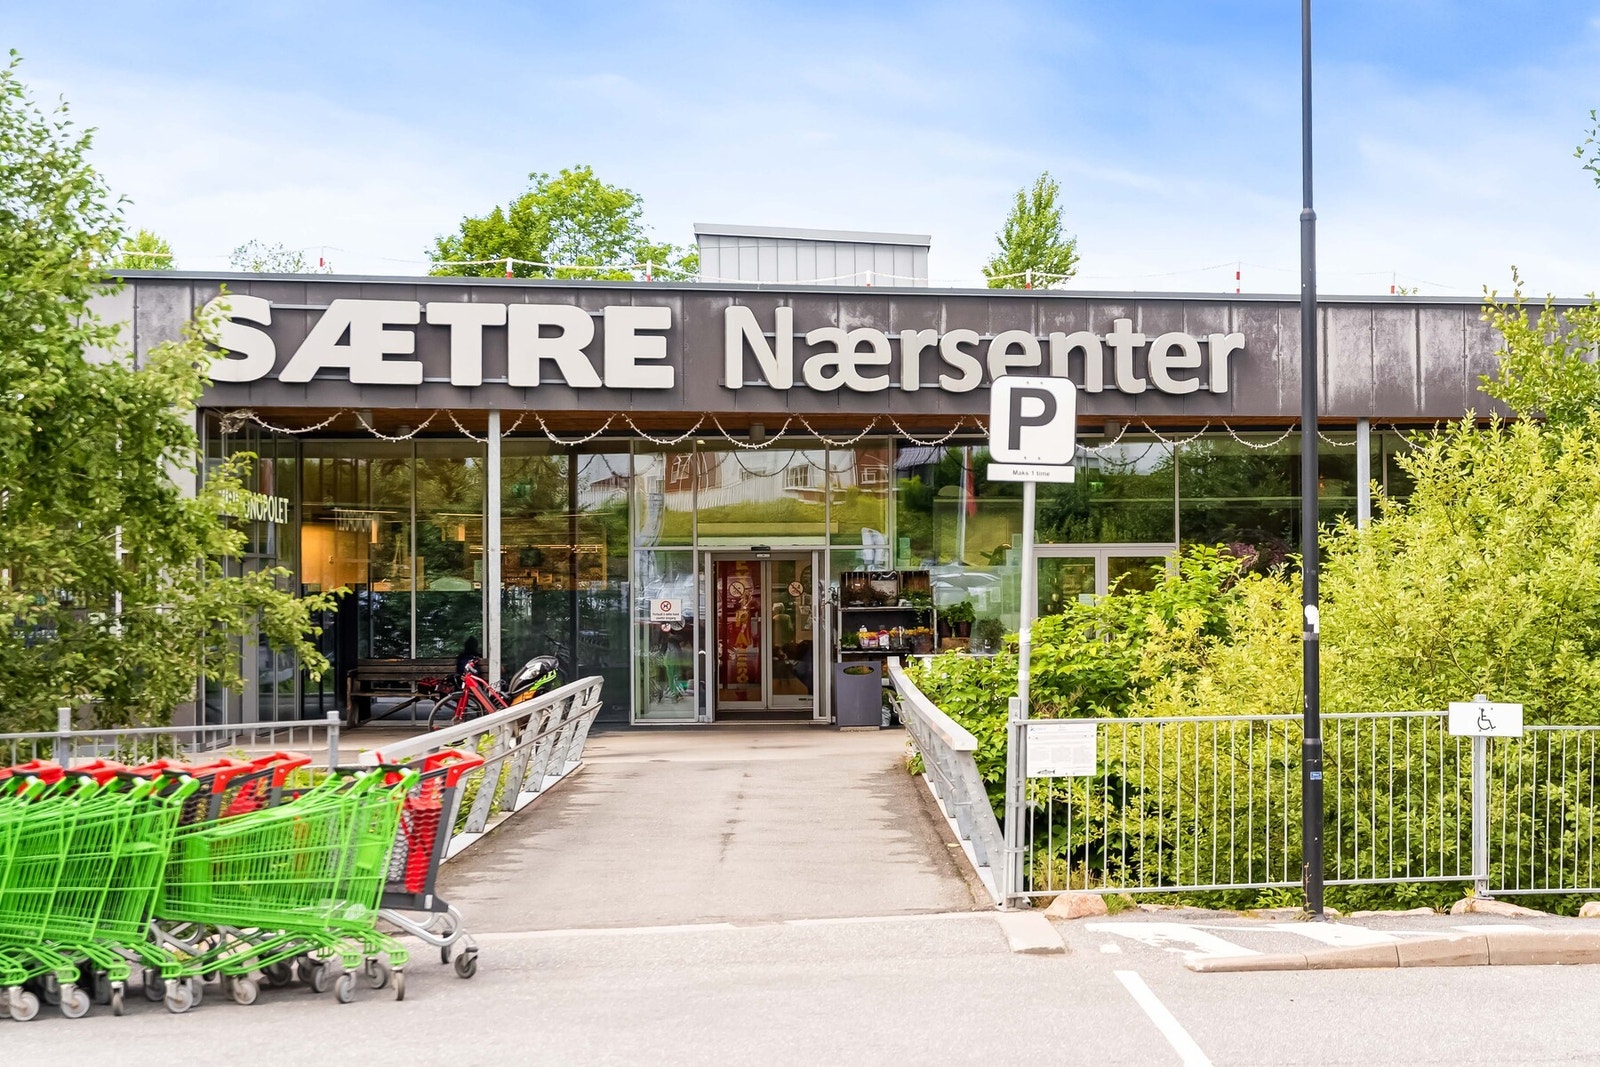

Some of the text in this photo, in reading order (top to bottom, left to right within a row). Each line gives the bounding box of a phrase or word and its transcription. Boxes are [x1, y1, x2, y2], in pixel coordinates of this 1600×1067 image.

[201, 294, 1246, 395] SÆTRE Nærsenter
[1008, 387, 1057, 450] P
[218, 488, 289, 525] IONOPOLET
